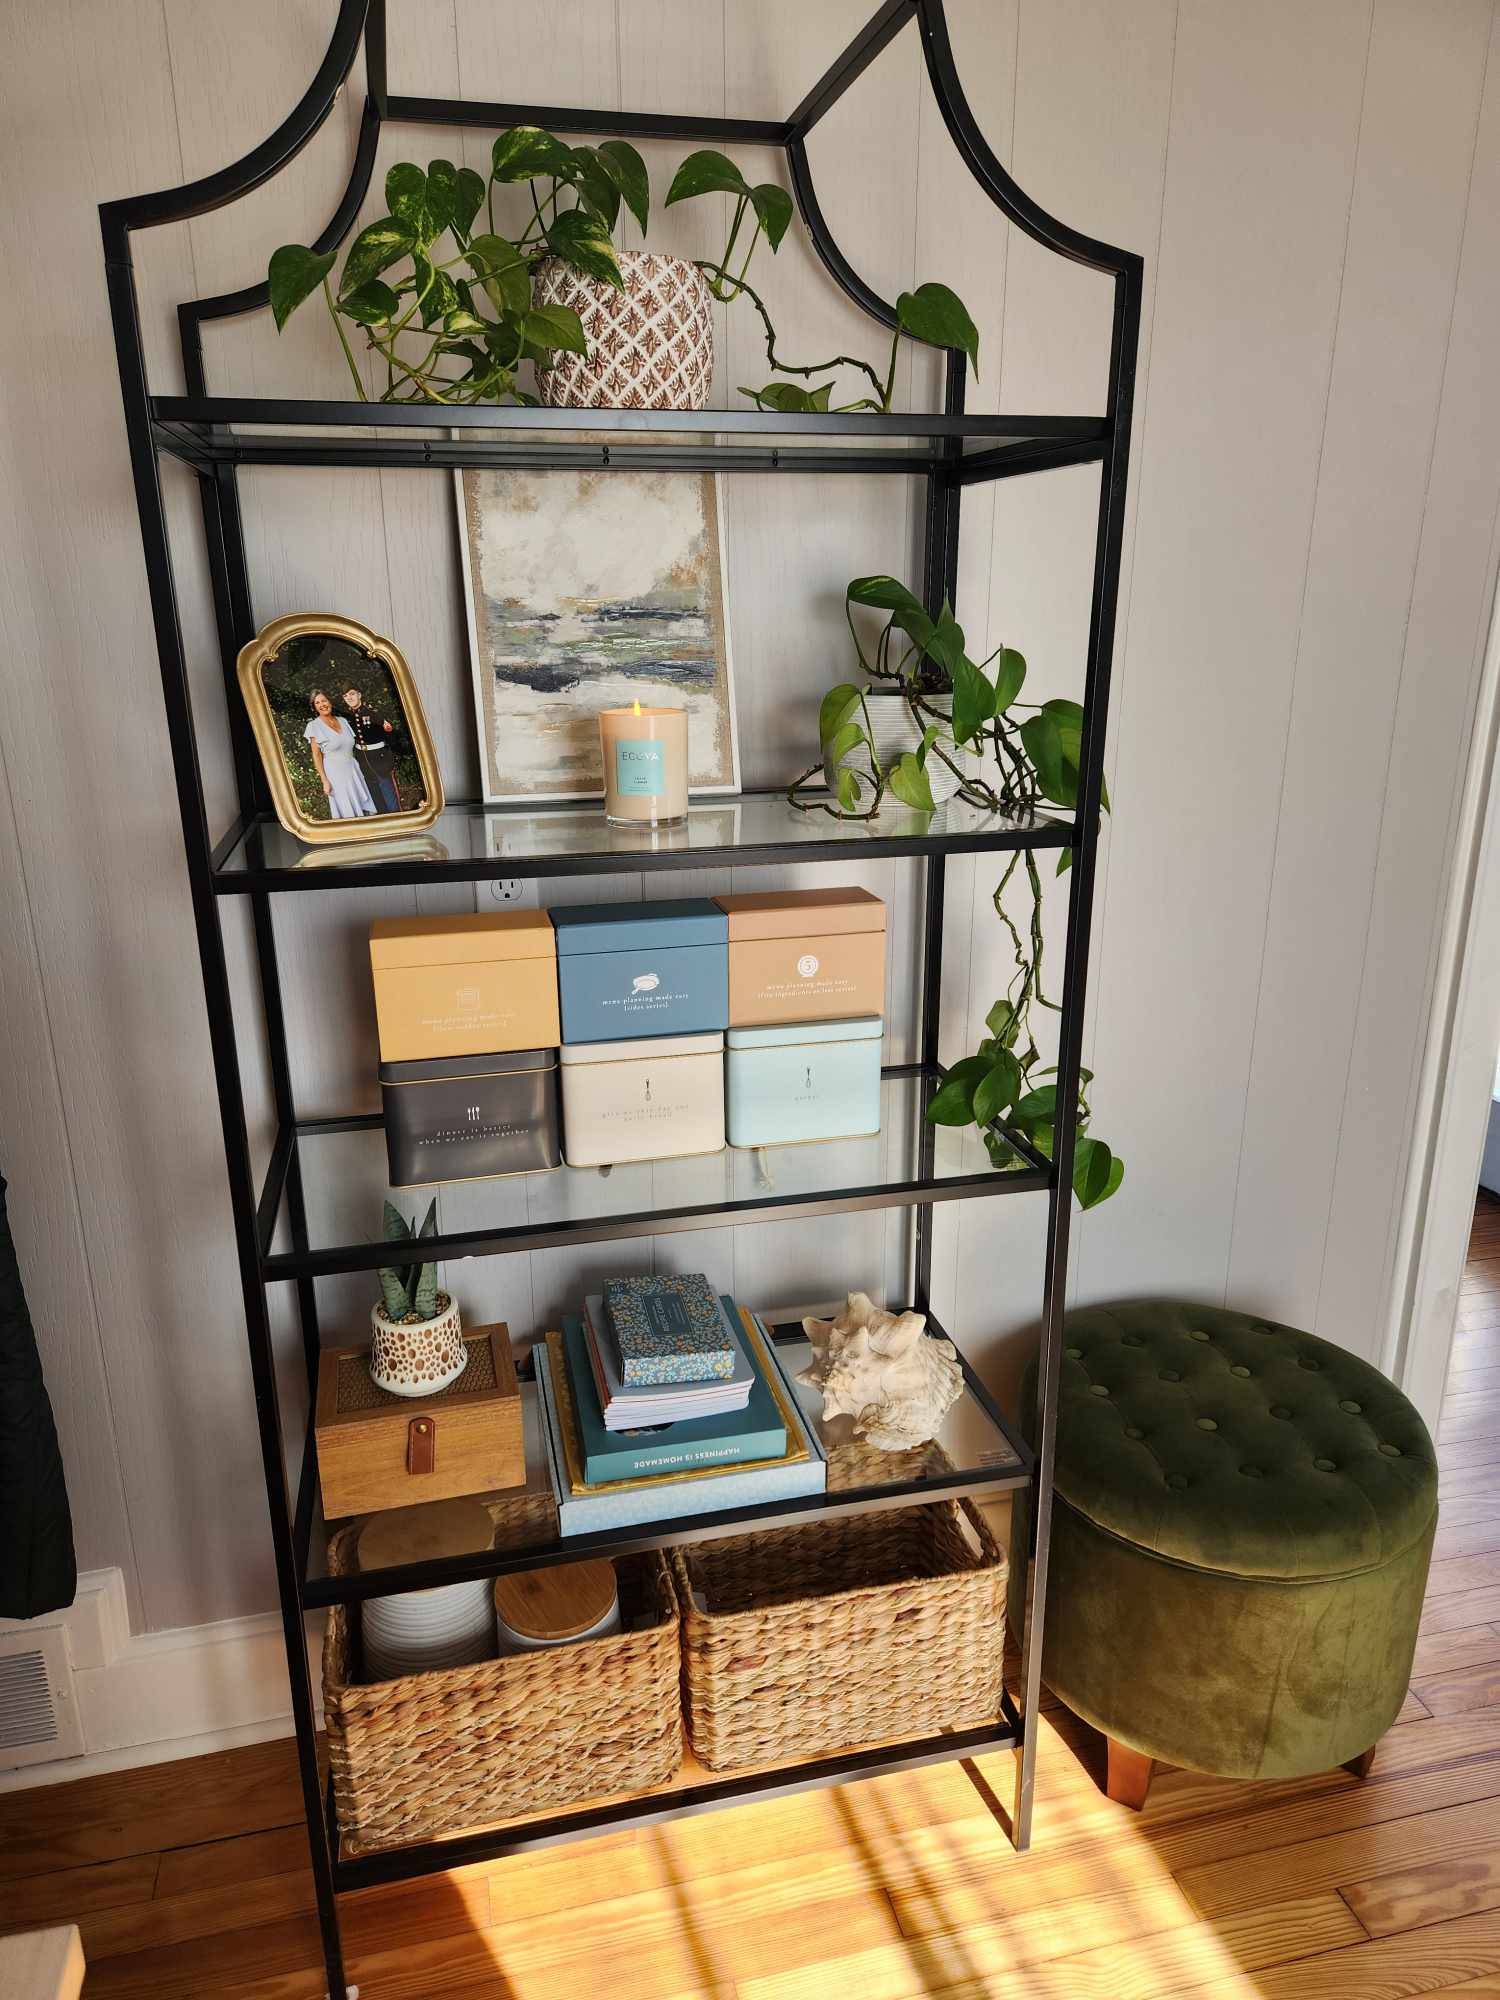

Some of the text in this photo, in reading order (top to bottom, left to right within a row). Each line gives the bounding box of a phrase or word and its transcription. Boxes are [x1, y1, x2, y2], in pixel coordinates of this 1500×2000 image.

[633, 1447, 740, 1469] HAPPINESS IS HOMEMADE
